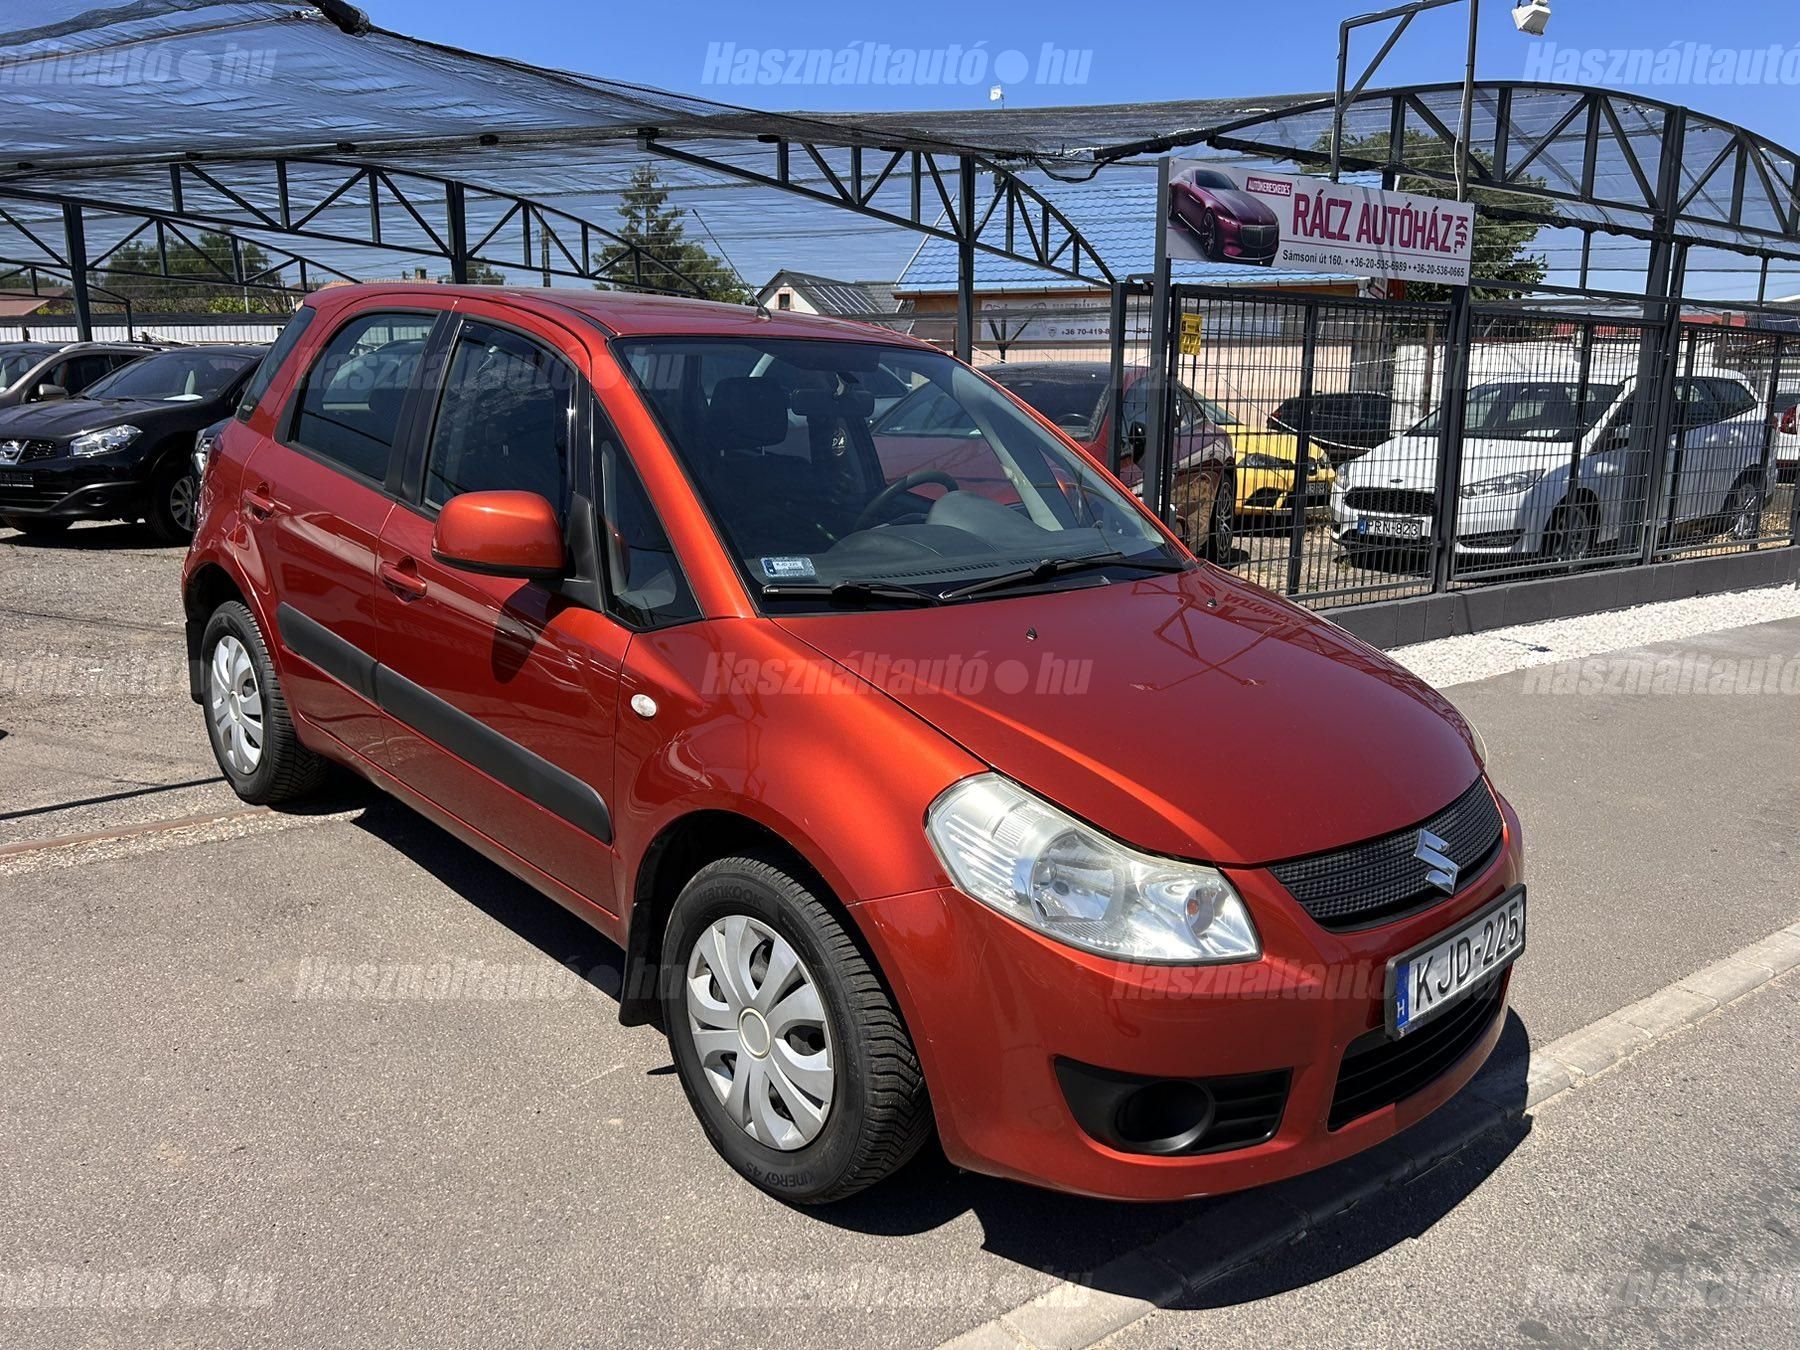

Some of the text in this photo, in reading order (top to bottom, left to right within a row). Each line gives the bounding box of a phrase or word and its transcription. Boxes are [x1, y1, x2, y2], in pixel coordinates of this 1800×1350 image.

[1292, 188, 1453, 253] RÁCZ AUTÓHÁZ
[1282, 249, 1317, 263] Sámsoni
[1319, 253, 1327, 264] út
[1329, 254, 1343, 266] 160.
[1415, 901, 1518, 1011] KJD-225
[1396, 1001, 1405, 1018] H
